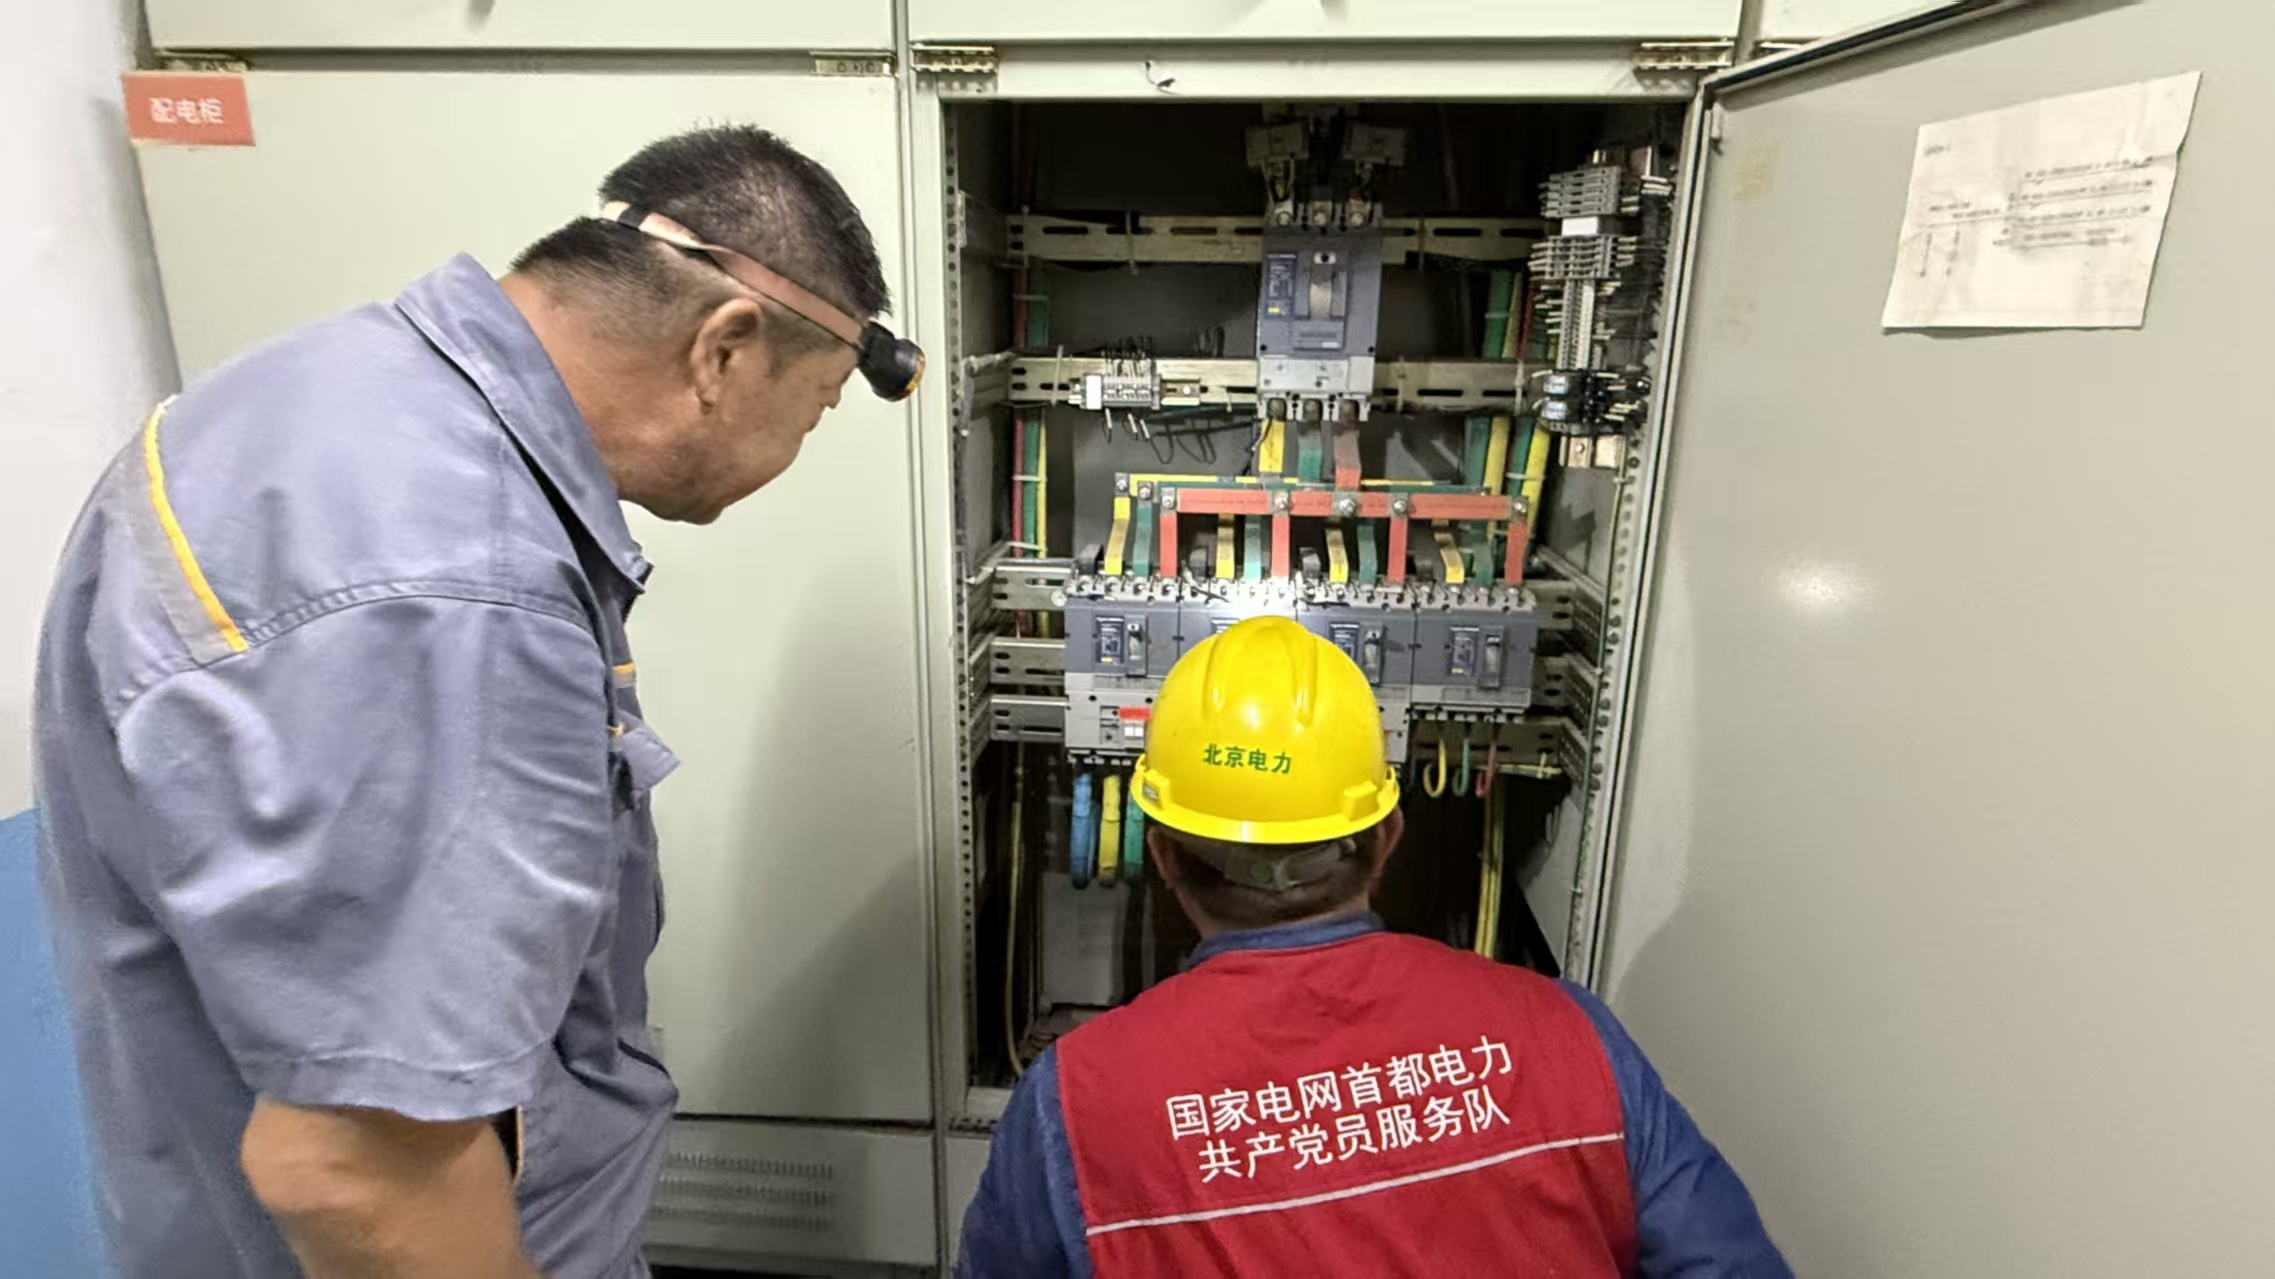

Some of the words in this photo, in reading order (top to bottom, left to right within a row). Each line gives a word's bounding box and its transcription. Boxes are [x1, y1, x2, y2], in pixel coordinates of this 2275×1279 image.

[149, 96, 224, 124] 配电柜
[1202, 743, 1292, 774] 北京电力
[1166, 1035, 1513, 1140] 国家电网首都电力
[1198, 1084, 1511, 1183] 共产党员服务队
